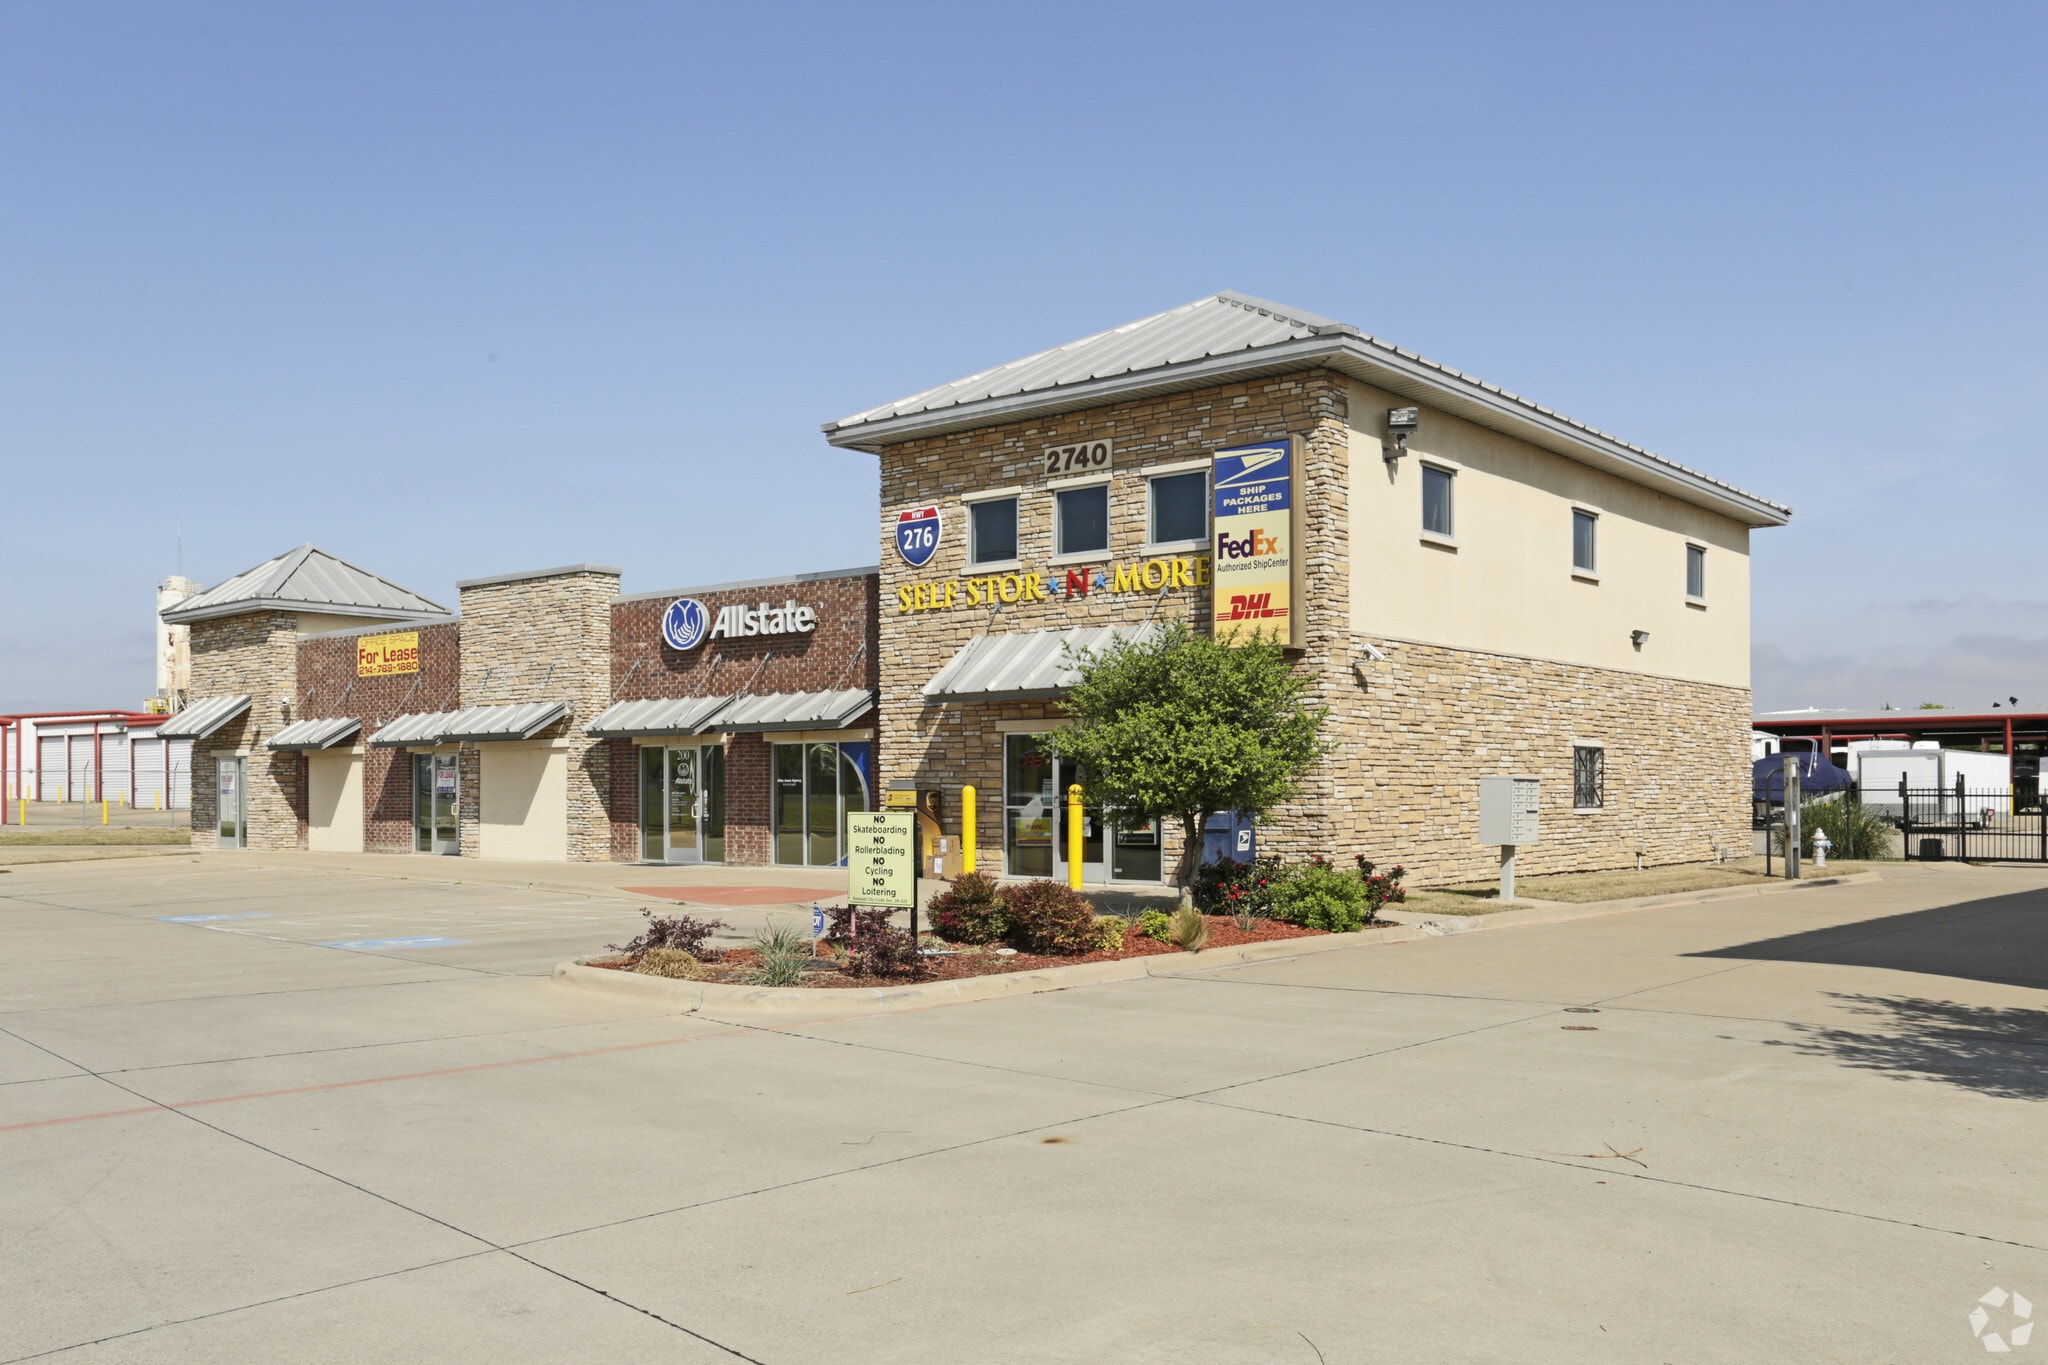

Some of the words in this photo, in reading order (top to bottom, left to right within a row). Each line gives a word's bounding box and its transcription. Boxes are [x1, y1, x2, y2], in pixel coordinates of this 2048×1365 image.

[1046, 443, 1108, 474] 2740
[1239, 485, 1267, 496] SHIP
[1222, 492, 1283, 507] PACKAGES
[1237, 503, 1269, 514] HERE
[911, 510, 925, 520] HWY
[903, 526, 933, 551] 276
[1217, 528, 1279, 560] FedEx
[1216, 561, 1252, 573] Authorized
[1253, 558, 1289, 571] ShipCenter
[899, 581, 958, 613] SELF
[966, 572, 1046, 607] STOR
[1065, 567, 1091, 599] N
[1112, 556, 1212, 594] MORE
[1230, 592, 1275, 621] DHL
[709, 600, 816, 639] Allstate
[361, 637, 387, 648] OFFICE
[389, 633, 416, 645] SPACE
[359, 648, 379, 665] For
[383, 646, 418, 663] Lease
[677, 750, 690, 760] 200
[873, 815, 886, 824] NO
[853, 825, 907, 836] Skateboarding
[873, 836, 885, 845] NO
[855, 845, 905, 857] Rollerblading
[872, 857, 885, 866] NO
[865, 866, 893, 877] Cycling
[872, 877, 885, 887] NO
[862, 887, 896, 899] Loitering
